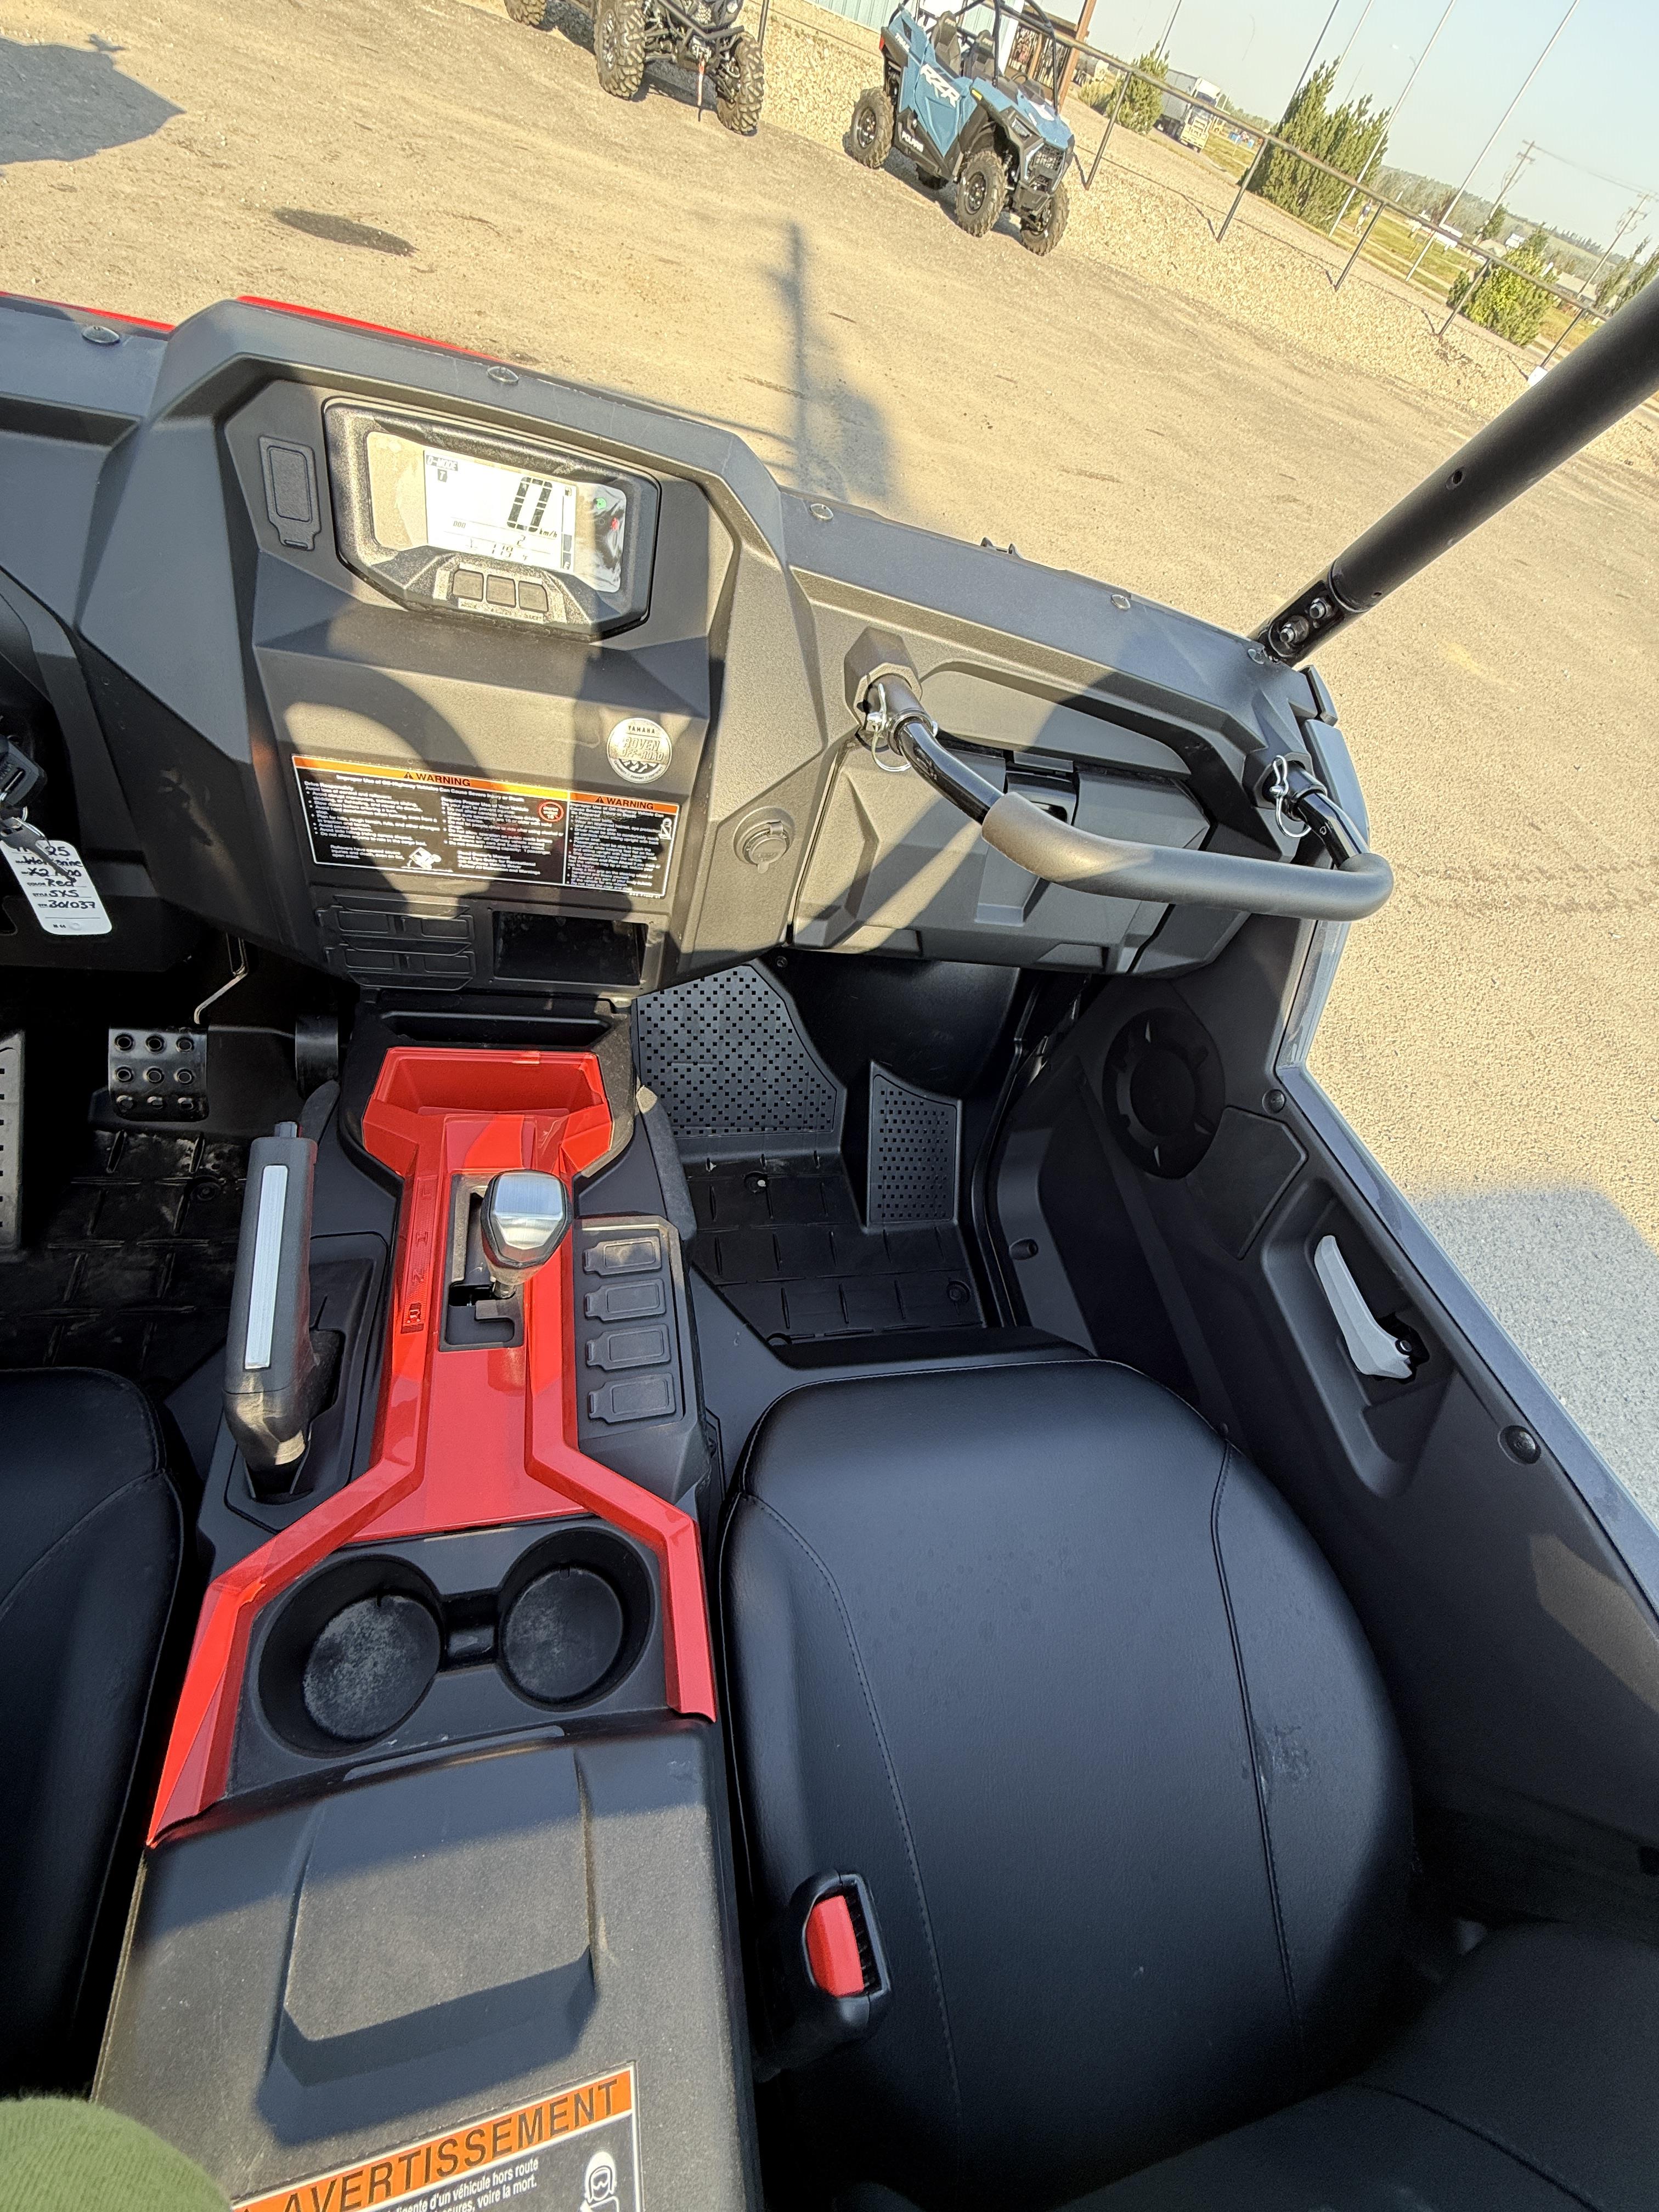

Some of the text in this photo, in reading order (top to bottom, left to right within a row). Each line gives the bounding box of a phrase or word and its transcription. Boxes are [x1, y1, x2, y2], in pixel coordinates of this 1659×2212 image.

[920, 63, 960, 108] RZR
[539, 528, 557, 538] km/h
[628, 725, 656, 734] YAMAHA
[415, 772, 471, 787] WARNING
[606, 797, 654, 810] WARNING
[44, 878, 77, 887] Red
[48, 900, 95, 909] 301037
[282, 2079, 619, 2212] AVERTISSEMENT
[430, 2192, 451, 2210] d'un
[453, 2175, 491, 2201] véhicule
[492, 2168, 514, 2187] hors
[515, 2158, 539, 2177] route
[477, 2190, 501, 2209] voire
[503, 2184, 511, 2199] la
[513, 2174, 537, 2195] mort.
